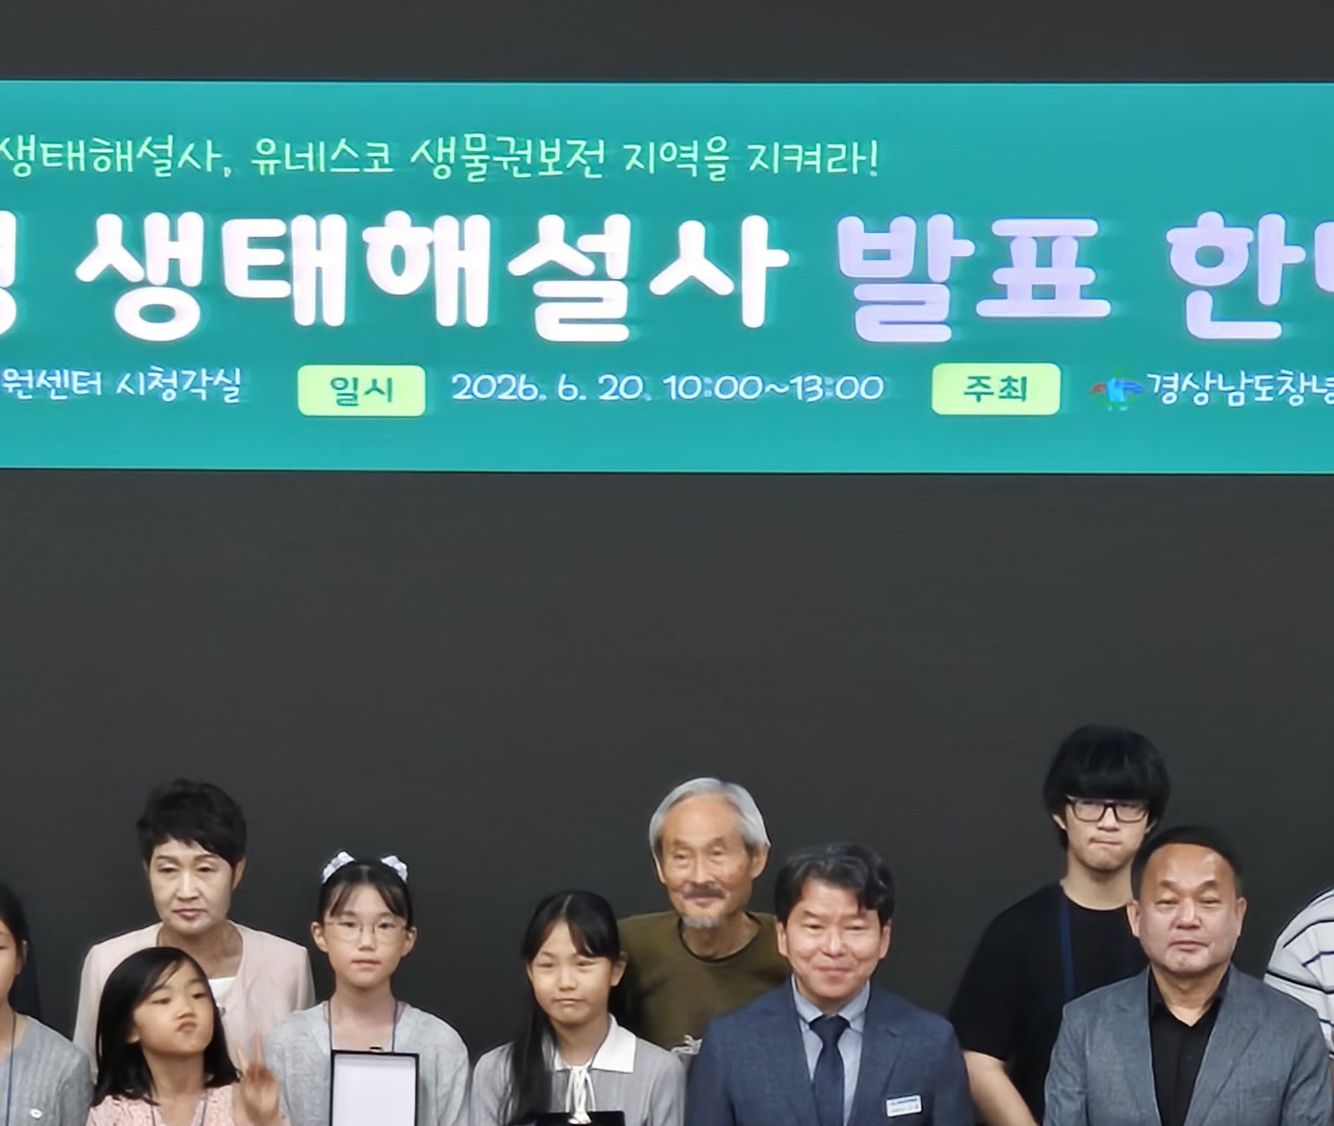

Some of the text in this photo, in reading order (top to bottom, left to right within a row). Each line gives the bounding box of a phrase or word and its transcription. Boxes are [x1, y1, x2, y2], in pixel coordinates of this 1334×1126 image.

[251, 137, 395, 176] 유네스코
[410, 133, 606, 183] 생물권보전
[623, 134, 731, 183] 지역을
[747, 138, 879, 178] 지켜라!
[76, 211, 790, 344] 생태해설사
[835, 211, 1113, 344] 발표
[116, 367, 243, 403] 시청각실
[329, 376, 395, 407] 일시
[450, 373, 548, 402] 2026.
[556, 373, 587, 402] 6.
[597, 373, 652, 402] 20.
[663, 373, 885, 404] 10:00~13:00
[963, 375, 1028, 403] 주최
